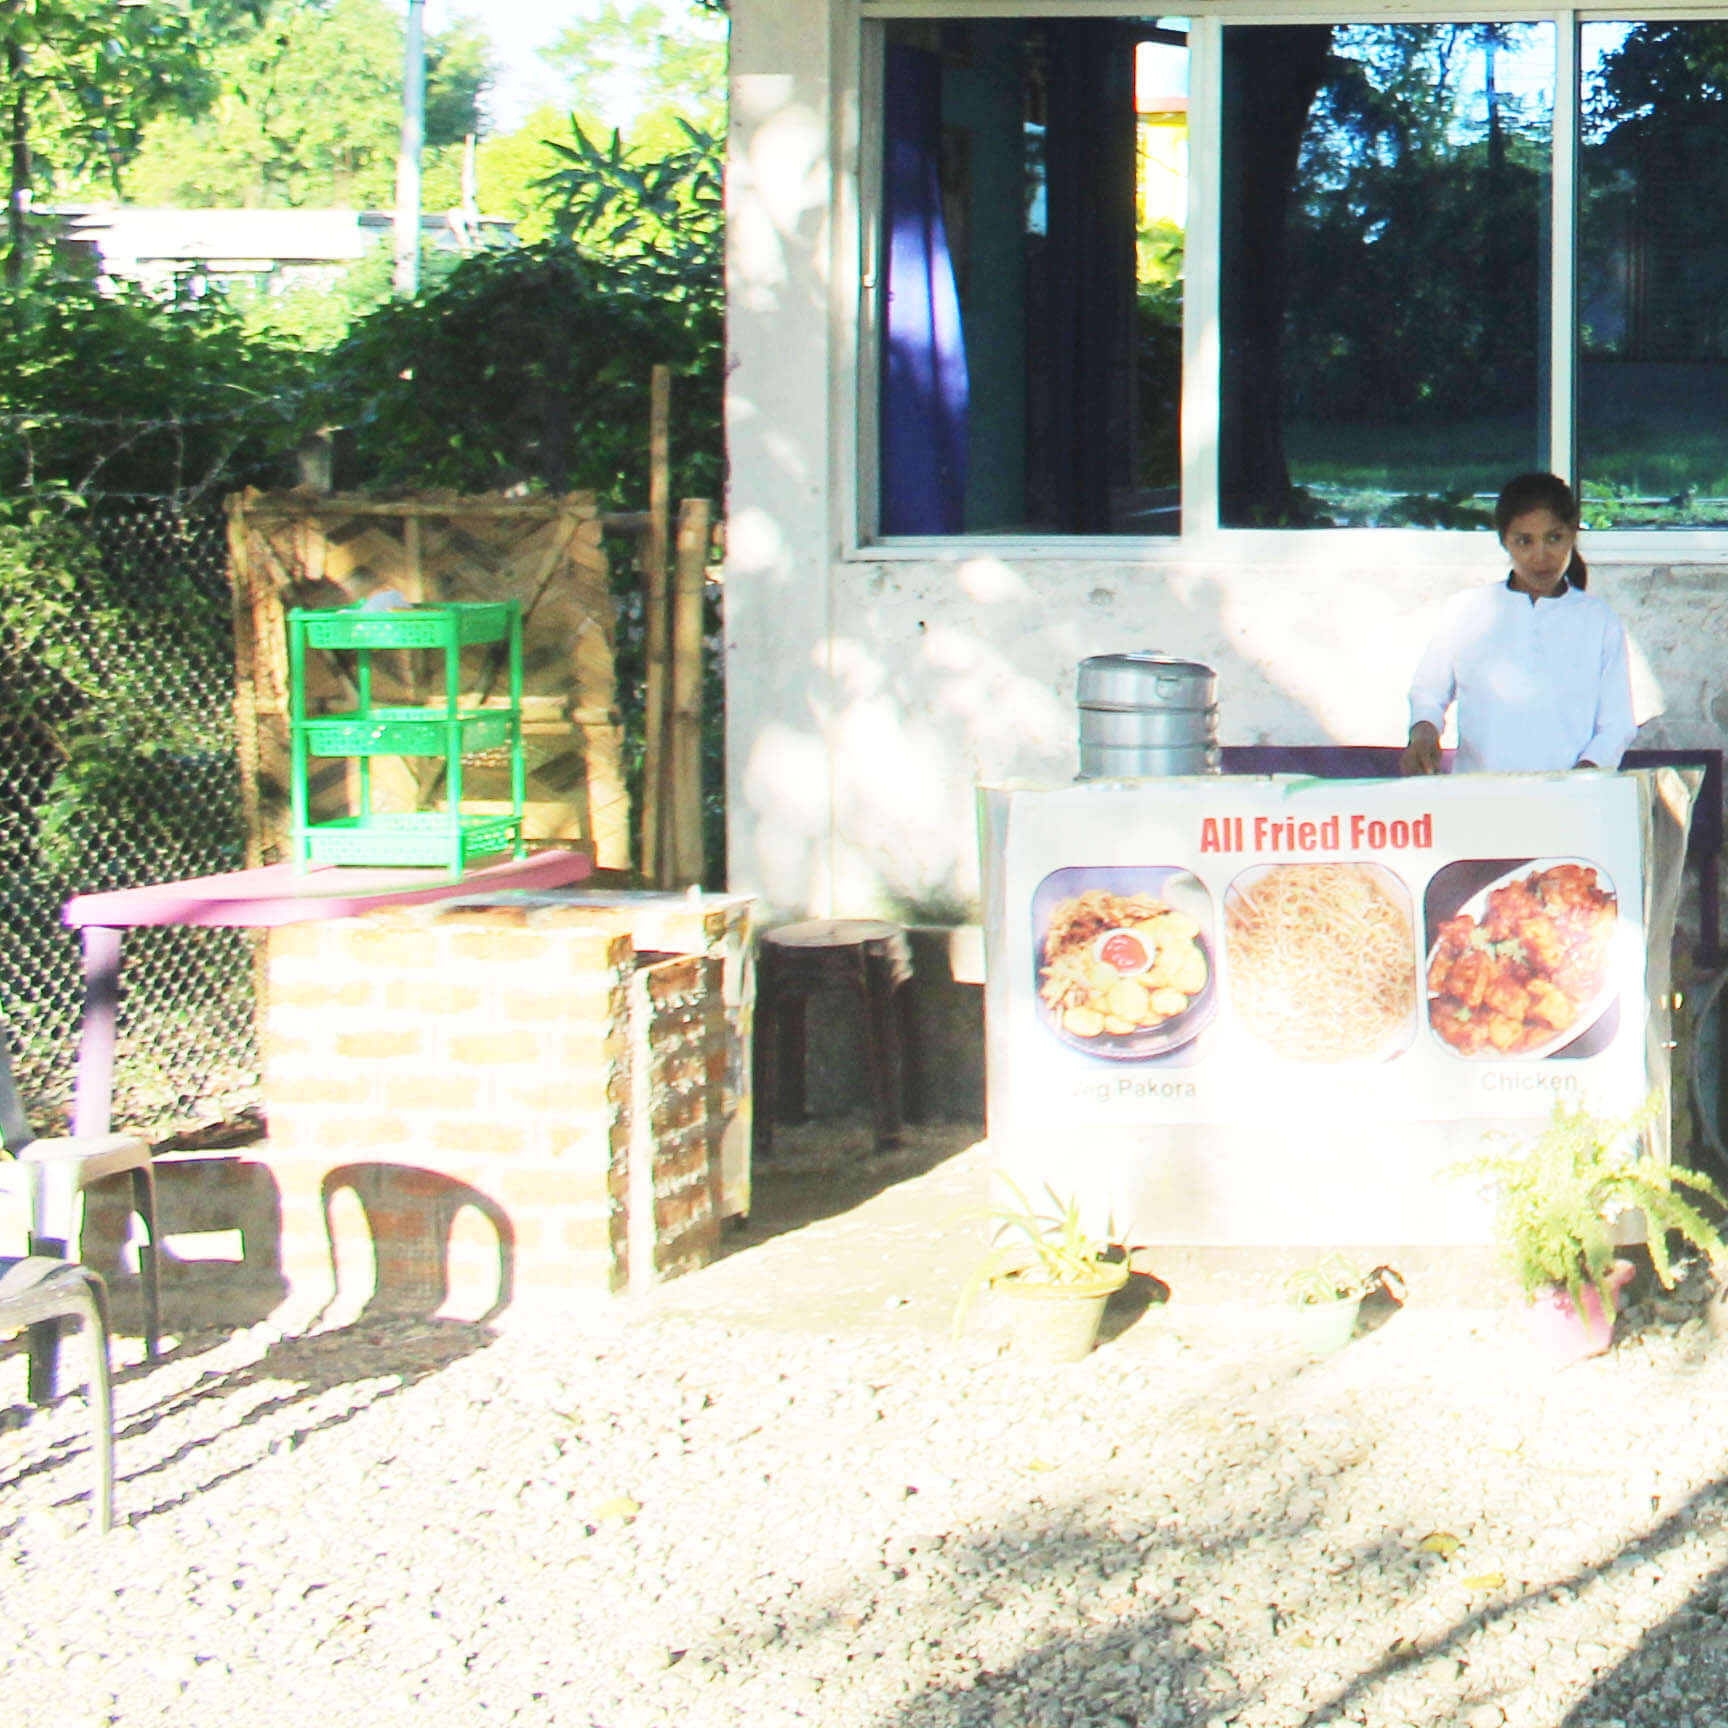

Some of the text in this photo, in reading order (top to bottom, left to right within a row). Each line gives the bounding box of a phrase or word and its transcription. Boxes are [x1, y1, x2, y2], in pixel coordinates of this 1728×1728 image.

[1200, 813, 1433, 853] All Fried Food
[1118, 1077, 1198, 1098] Pakora
[1481, 1071, 1578, 1091] Chicken
